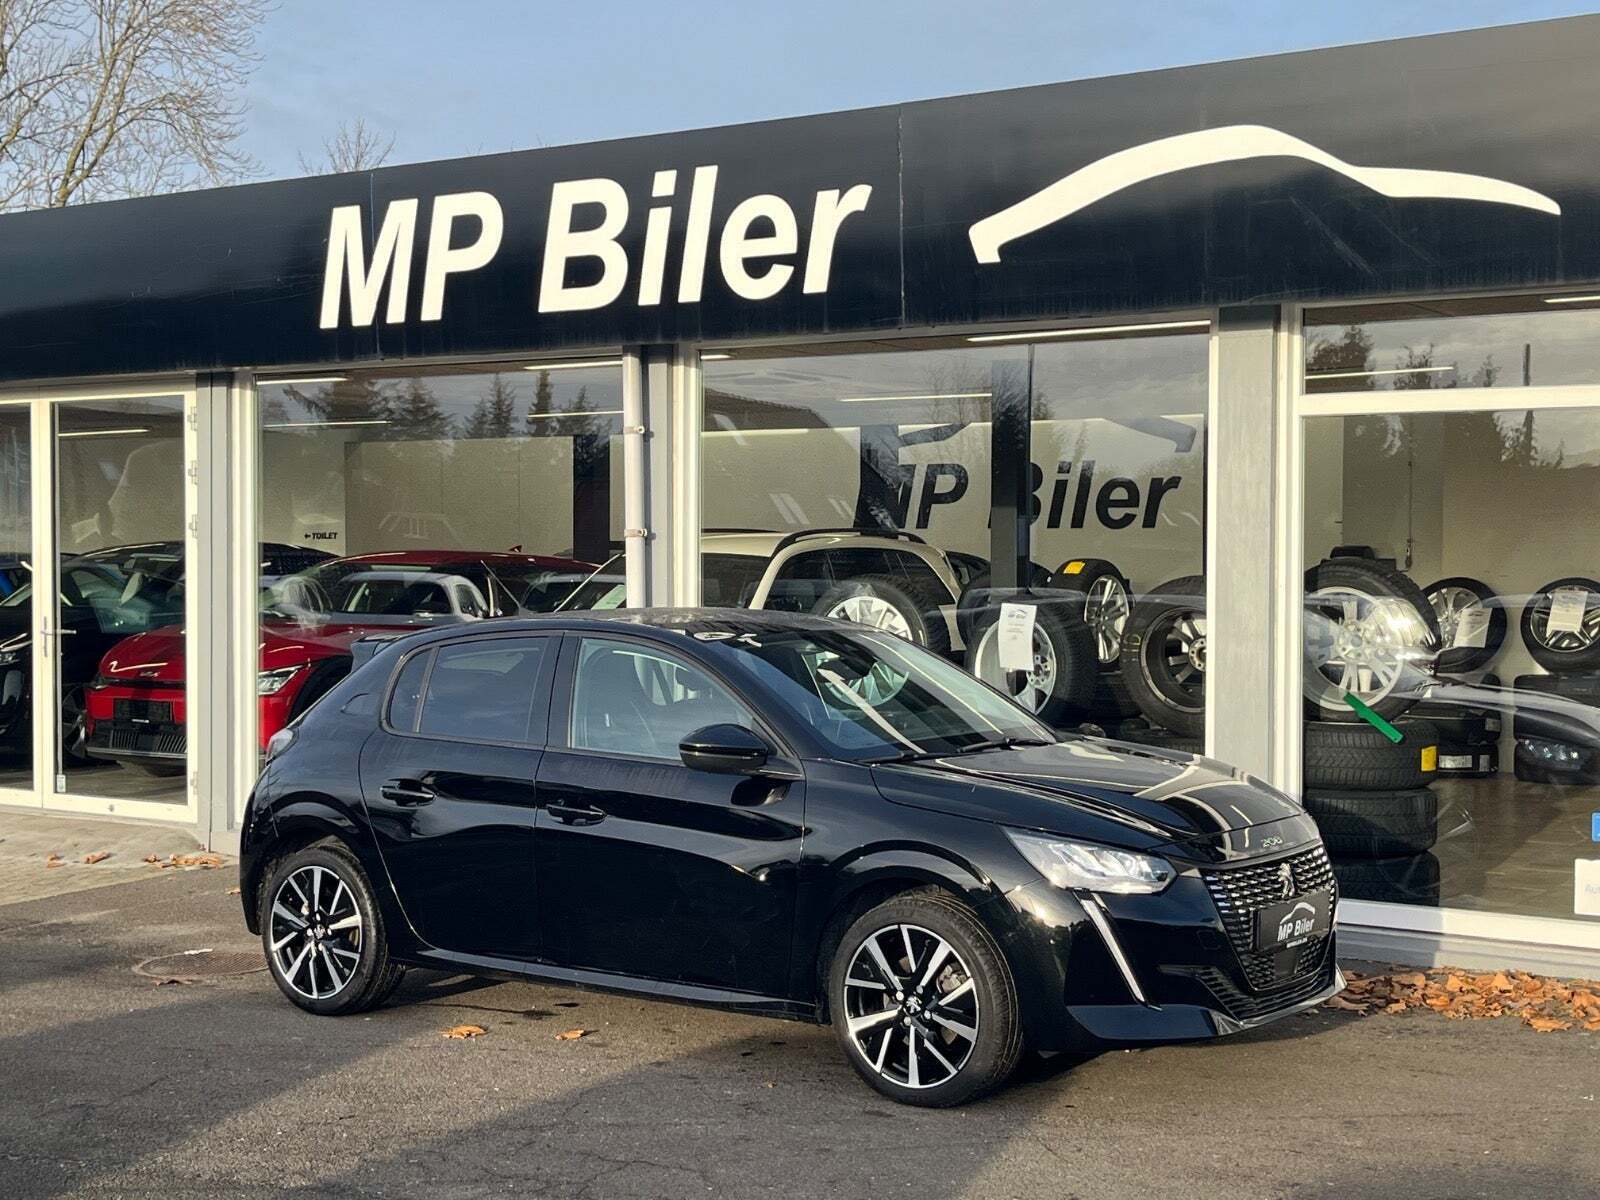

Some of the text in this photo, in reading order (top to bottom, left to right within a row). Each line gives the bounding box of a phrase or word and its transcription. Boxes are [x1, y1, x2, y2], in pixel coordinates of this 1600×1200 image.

[319, 165, 873, 330] MP Biler
[988, 460, 1182, 530] iler
[1278, 919, 1314, 941] MP Biler
